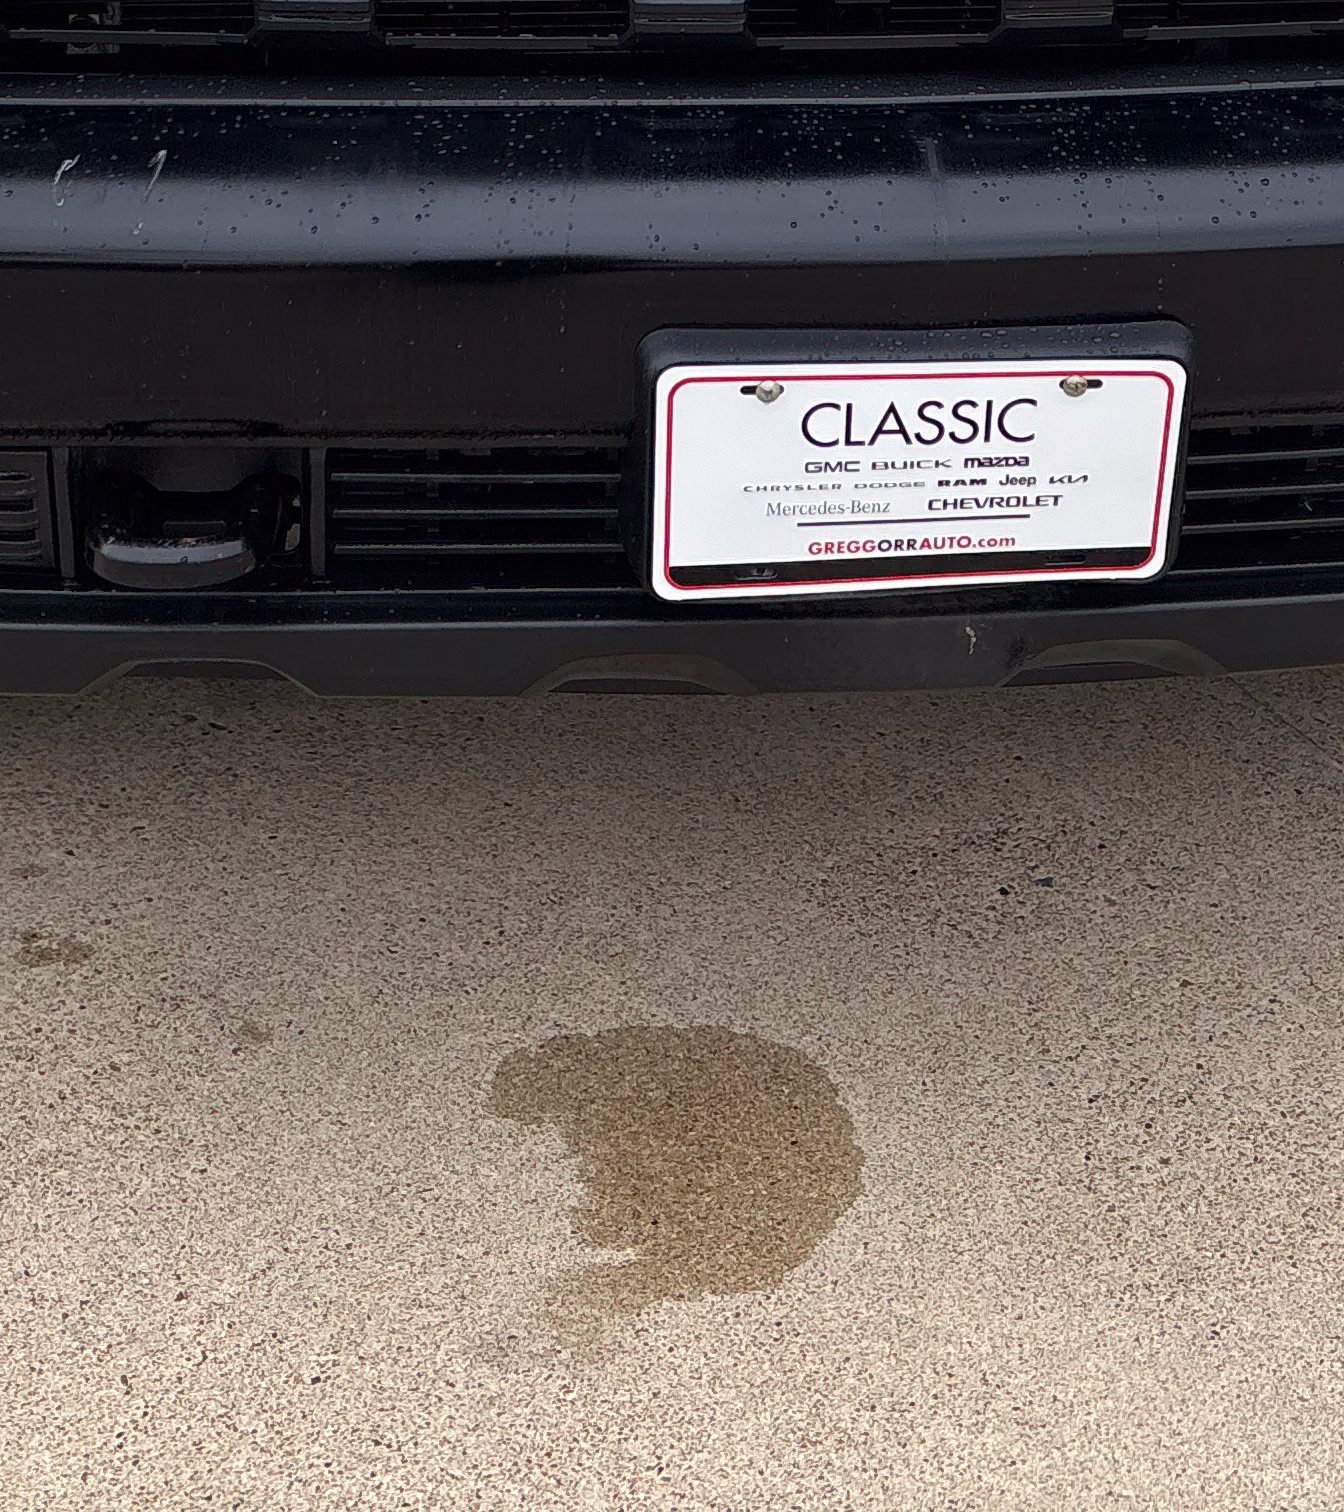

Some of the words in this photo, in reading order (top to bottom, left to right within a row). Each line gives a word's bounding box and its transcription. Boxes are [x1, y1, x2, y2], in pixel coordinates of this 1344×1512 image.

[801, 398, 1038, 448] CLASSIC
[805, 460, 861, 474] GMC
[871, 459, 953, 471] BUICK
[743, 483, 842, 493] CHRYSLER
[854, 481, 926, 490] DODGE
[937, 478, 987, 488] RAM
[999, 474, 1037, 488] Jeep
[766, 500, 891, 518] Mercedes-Benz
[927, 494, 1064, 512] CHEVROLET
[807, 535, 1016, 556] GREGGORRAUTO.com
